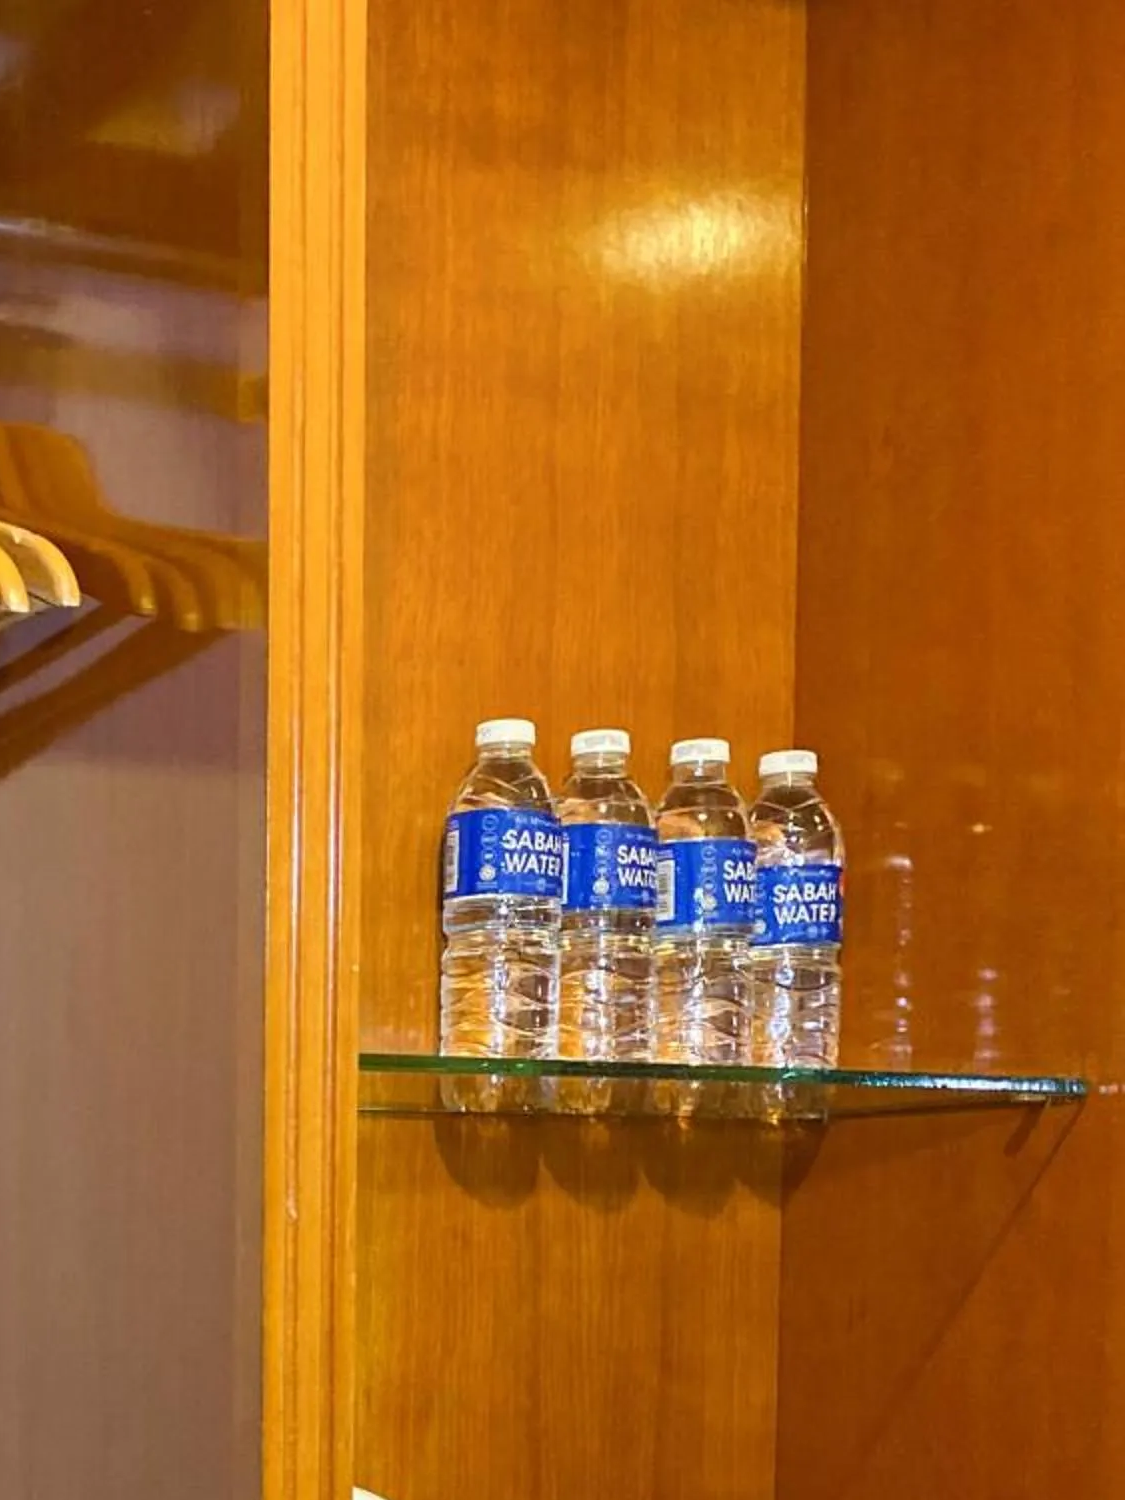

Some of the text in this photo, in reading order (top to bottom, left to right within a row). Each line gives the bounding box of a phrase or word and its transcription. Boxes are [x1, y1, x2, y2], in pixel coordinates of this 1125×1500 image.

[501, 829, 562, 854] SABAH
[617, 844, 656, 867] SABA
[617, 866, 656, 889] WATE
[723, 859, 756, 881] SAB
[723, 881, 756, 903] WAT
[773, 882, 836, 903] SABAH
